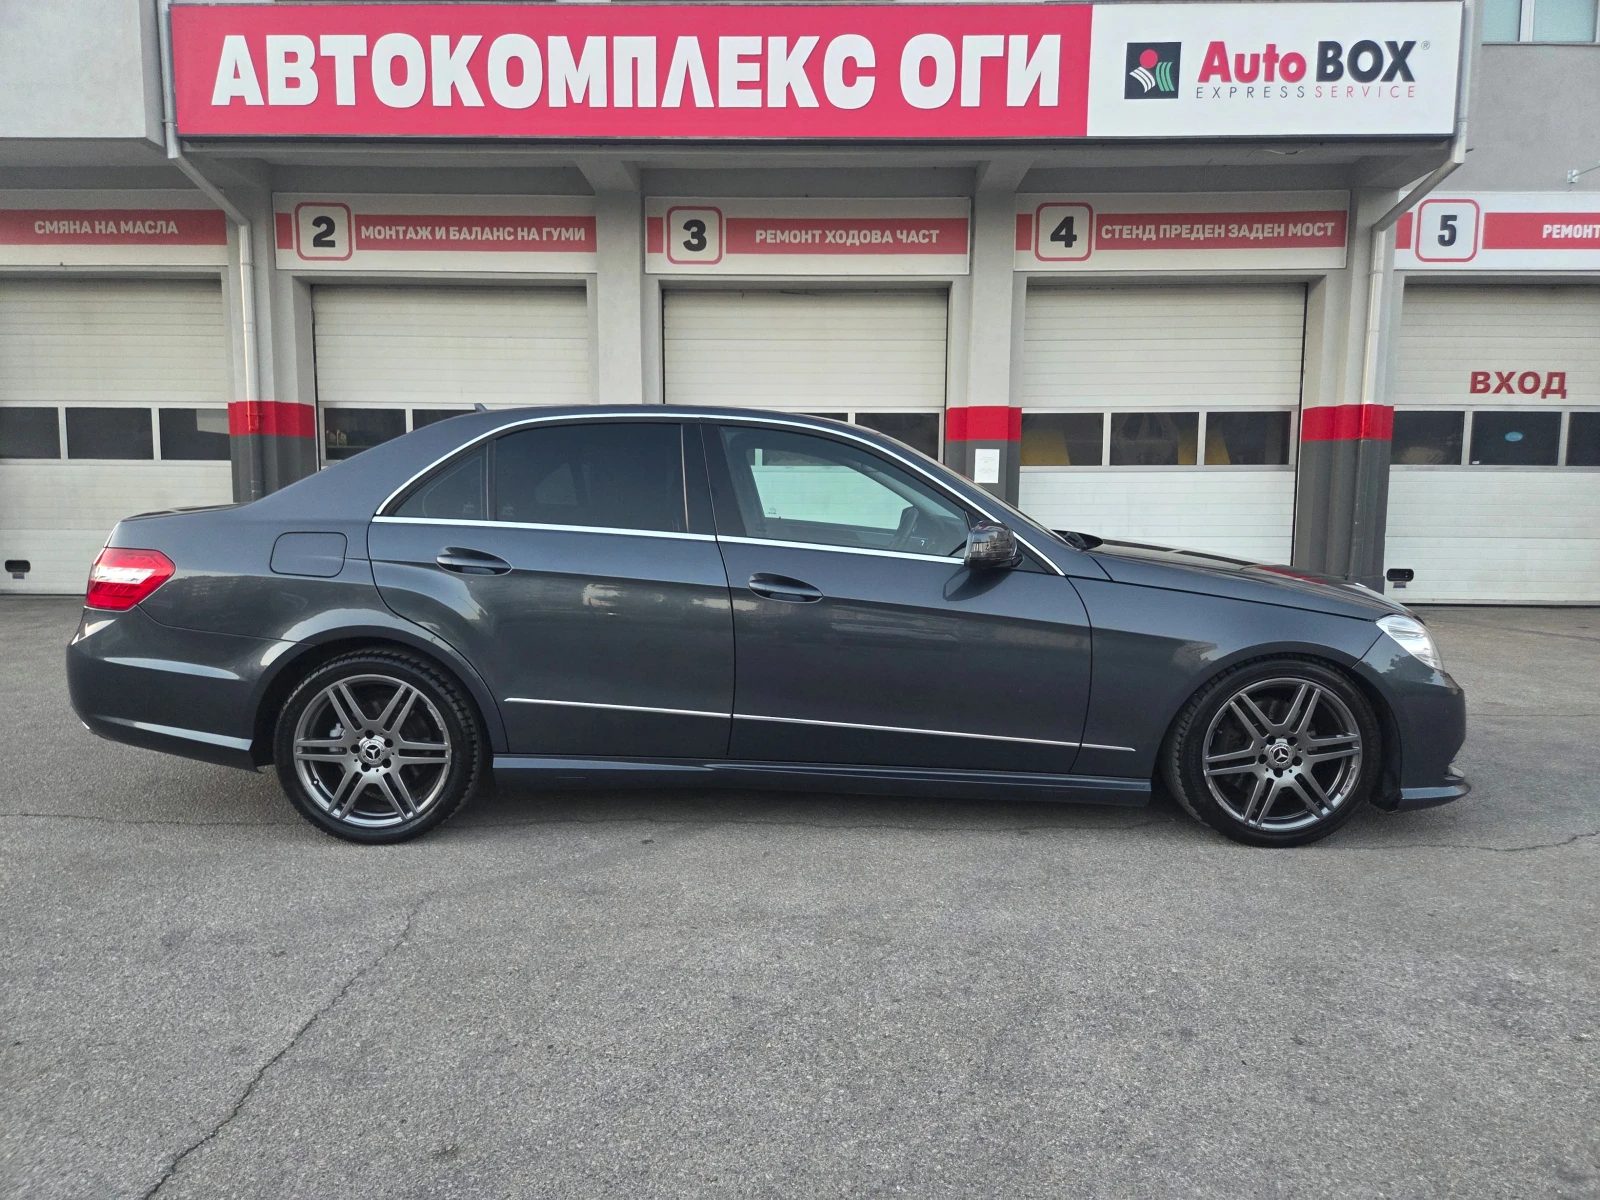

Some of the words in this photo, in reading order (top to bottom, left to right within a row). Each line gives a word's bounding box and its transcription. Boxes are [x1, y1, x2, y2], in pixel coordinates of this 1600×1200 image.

[211, 32, 877, 110] АВТОКОМПЛЕКС
[900, 33, 1062, 109] ОГИ
[1197, 41, 1307, 83] Auto
[34, 220, 92, 234] СМЯНА
[95, 220, 118, 234] НА
[120, 220, 179, 234] МАСЛА
[311, 215, 336, 248] 2
[361, 225, 432, 240] МОНТАЖ
[435, 227, 446, 240] И
[449, 227, 515, 241] БАЛАНС
[517, 227, 540, 241] НА
[542, 227, 586, 241] ГУМИ
[682, 219, 707, 252] 3
[755, 229, 822, 244] РЕМОНТ
[824, 229, 894, 246] ХОДОВА
[896, 229, 940, 244] ЧАСТ
[1049, 216, 1078, 248] 4
[1101, 224, 1156, 241] СТЕНД
[1159, 224, 1225, 241] ПРЕДЕН
[1228, 223, 1285, 240] ЗАДЕН
[1288, 222, 1335, 237] МОСТ
[1437, 214, 1458, 247] 5
[1469, 371, 1567, 399] ВХОД
